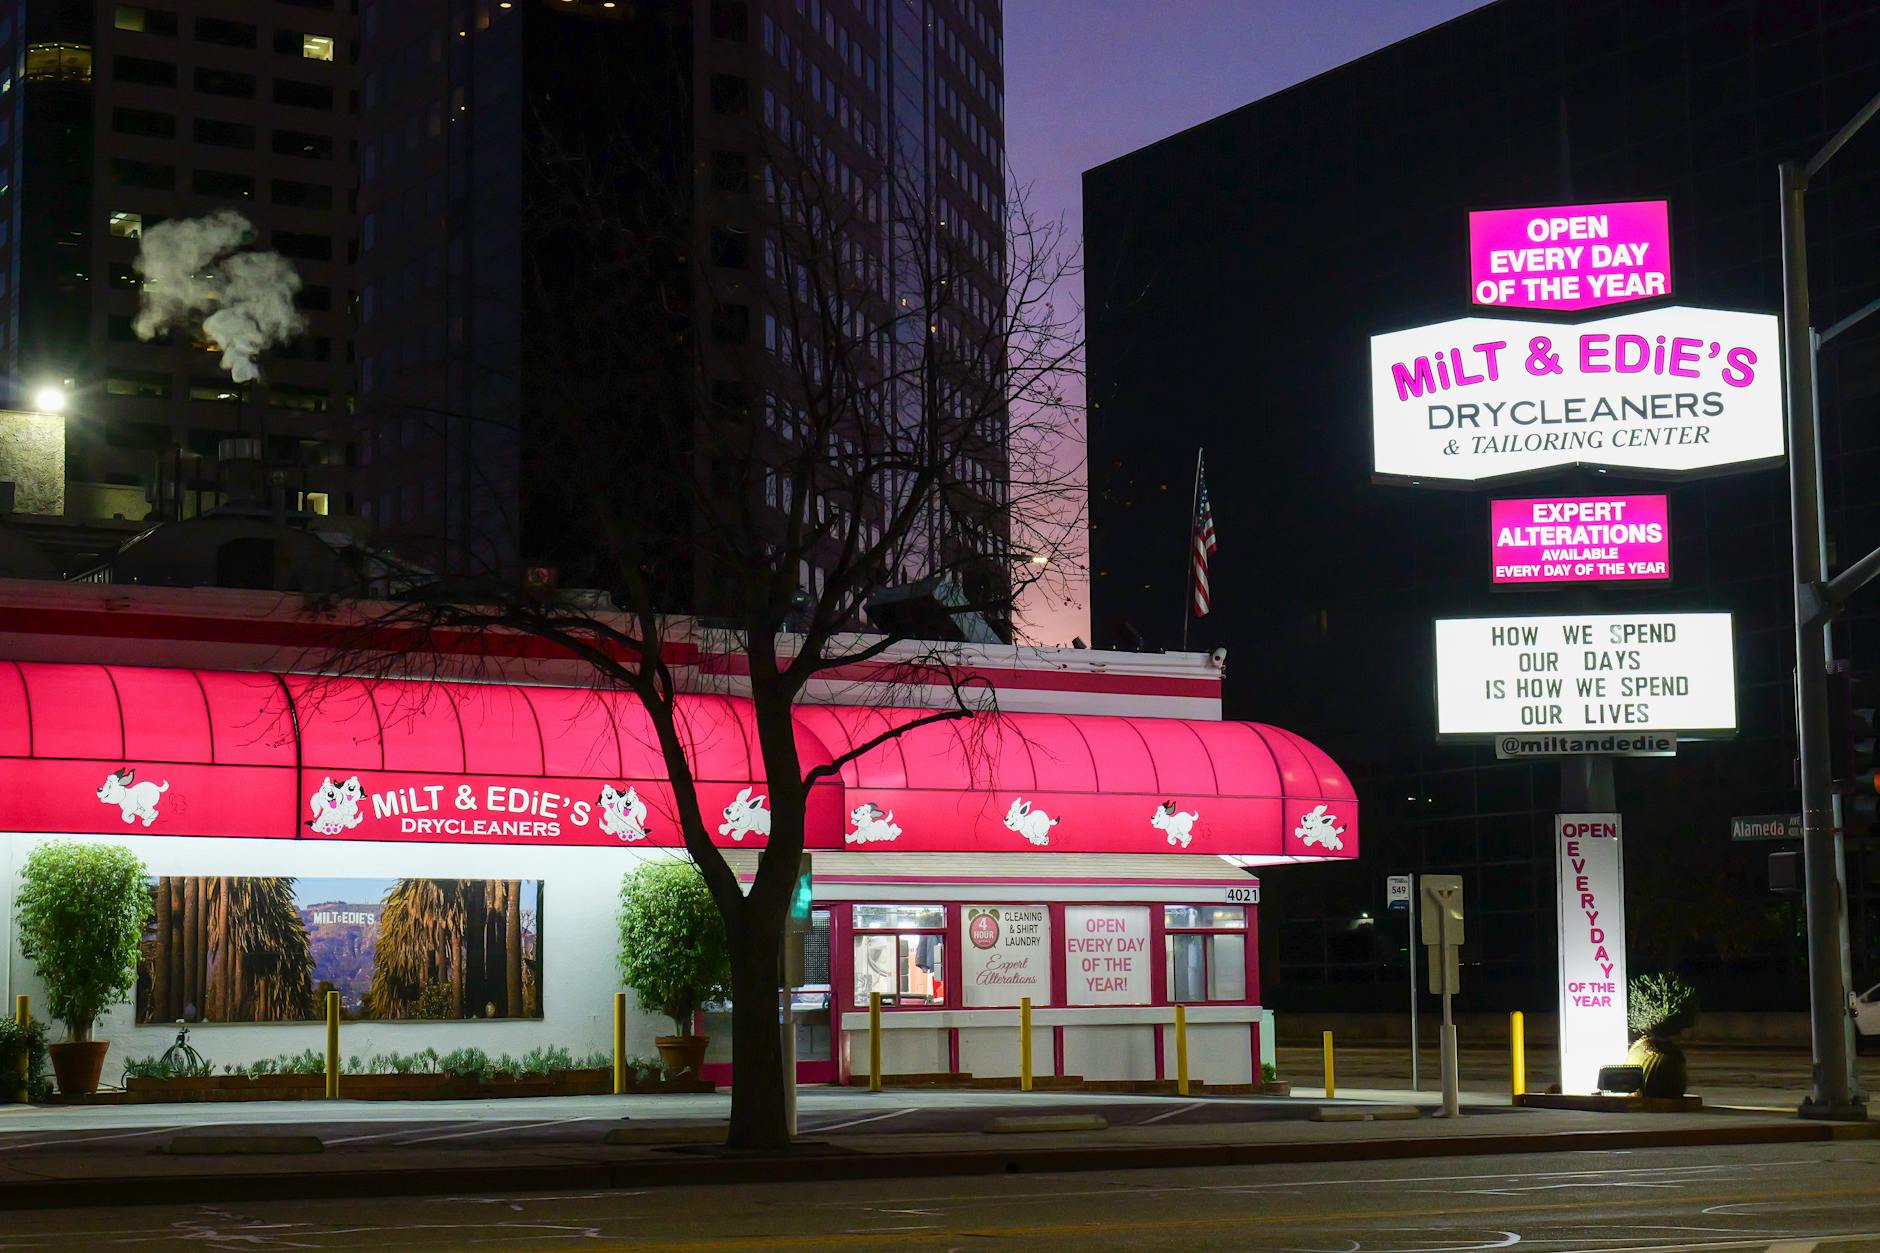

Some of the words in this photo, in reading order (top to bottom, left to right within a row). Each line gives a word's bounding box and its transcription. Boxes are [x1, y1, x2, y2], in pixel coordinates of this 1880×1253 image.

[1526, 216, 1608, 242] OPEN
[1490, 246, 1584, 274] EVERY
[1592, 243, 1649, 268] DAY
[1476, 279, 1515, 304] OF
[1521, 276, 1580, 301] THE
[1586, 272, 1665, 298] YEAR
[1391, 340, 1507, 401] MiLT
[1524, 335, 1563, 377] &
[1427, 391, 1724, 430] DRYCLEANERS
[1442, 438, 1460, 455] &
[1471, 430, 1604, 454] TAILORING
[1612, 425, 1711, 448] CENTER
[1532, 501, 1626, 523] EXPERT
[1497, 524, 1663, 547] ALTERATIONS
[1541, 548, 1618, 561] AVAILABLE
[1496, 564, 1540, 578] EVERY
[1544, 564, 1572, 576] DAY
[1574, 563, 1594, 576] OF
[1596, 562, 1625, 575] THE
[1628, 561, 1666, 574] YEAR
[1492, 626, 1538, 646] HOW
[1562, 625, 1593, 644] WE
[1610, 622, 1676, 644] SPEND
[1518, 652, 1558, 672] OUR
[1584, 650, 1641, 671] DAYS
[1486, 680, 1506, 700] IS
[1516, 678, 1563, 698] HOW
[1576, 678, 1606, 698] WE
[1620, 676, 1689, 697] SPEND
[1521, 704, 1562, 725] OUR
[1584, 702, 1650, 724] LIVES
[1501, 736, 1670, 755] @miltandedie
[454, 784, 478, 811] &
[401, 818, 560, 837] DRYCLEANERS
[1562, 823, 1616, 838] OPEN
[1733, 820, 1784, 837] Alameda
[1228, 888, 1257, 902] 4021
[1392, 886, 1406, 894] 549
[978, 917, 988, 930] 4
[1004, 912, 1042, 922] CLEANING
[1086, 918, 1126, 932] OPEN
[974, 930, 994, 939] HOUR
[1010, 924, 1014, 934] &
[1016, 924, 1038, 934] SHIRT
[1005, 936, 1040, 946] LAUNDRY
[1068, 938, 1114, 952] EVERY
[1117, 938, 1145, 952] DAY
[986, 954, 1028, 974] Expert
[1082, 958, 1100, 972] OF
[1104, 958, 1132, 972] THE
[976, 970, 1038, 986] Alterations
[1086, 977, 1128, 992] YEAR!
[1568, 982, 1586, 993] OF
[1588, 982, 1615, 993] THE
[1572, 995, 1612, 1007] YEAR
